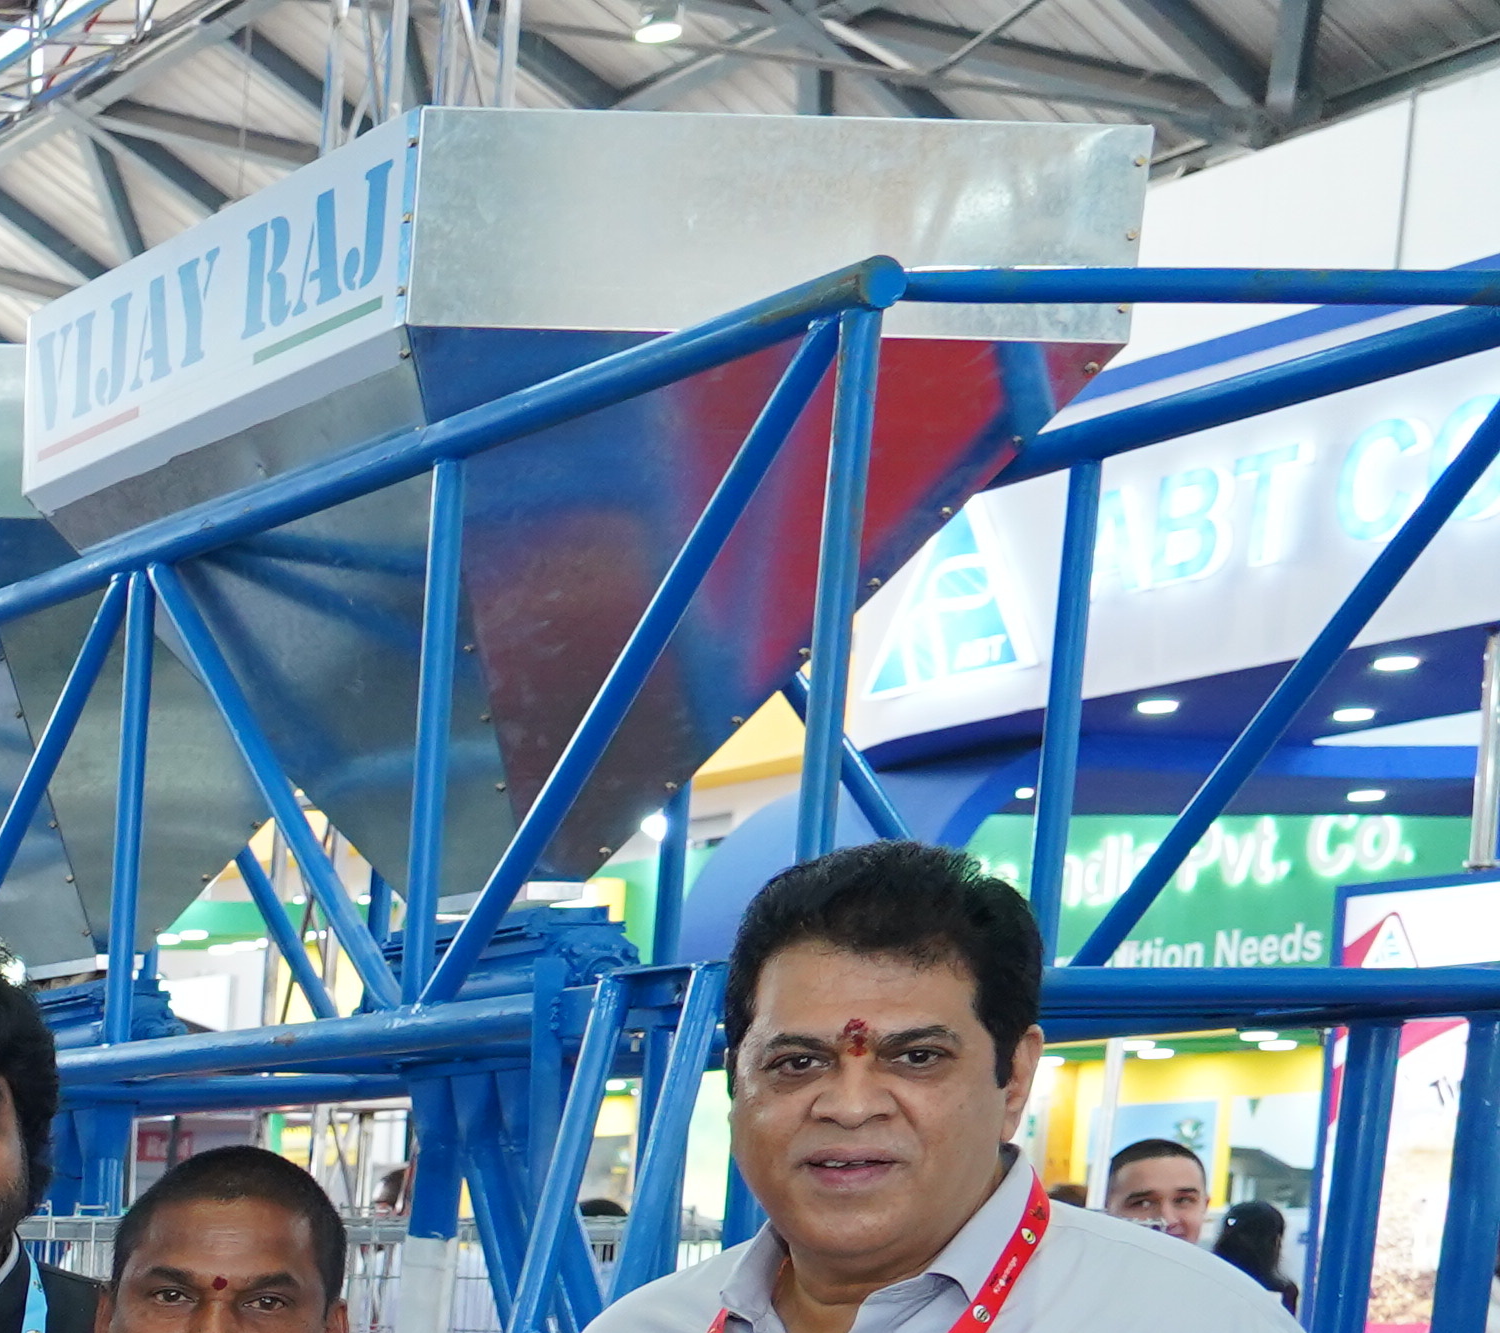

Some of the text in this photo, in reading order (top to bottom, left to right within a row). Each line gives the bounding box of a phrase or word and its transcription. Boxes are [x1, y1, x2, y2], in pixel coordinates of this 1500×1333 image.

[35, 158, 395, 433] VIJAY RAJ
[1092, 440, 1314, 594] ABT
[1306, 814, 1416, 876] Co.
[1213, 922, 1323, 968] Needs
